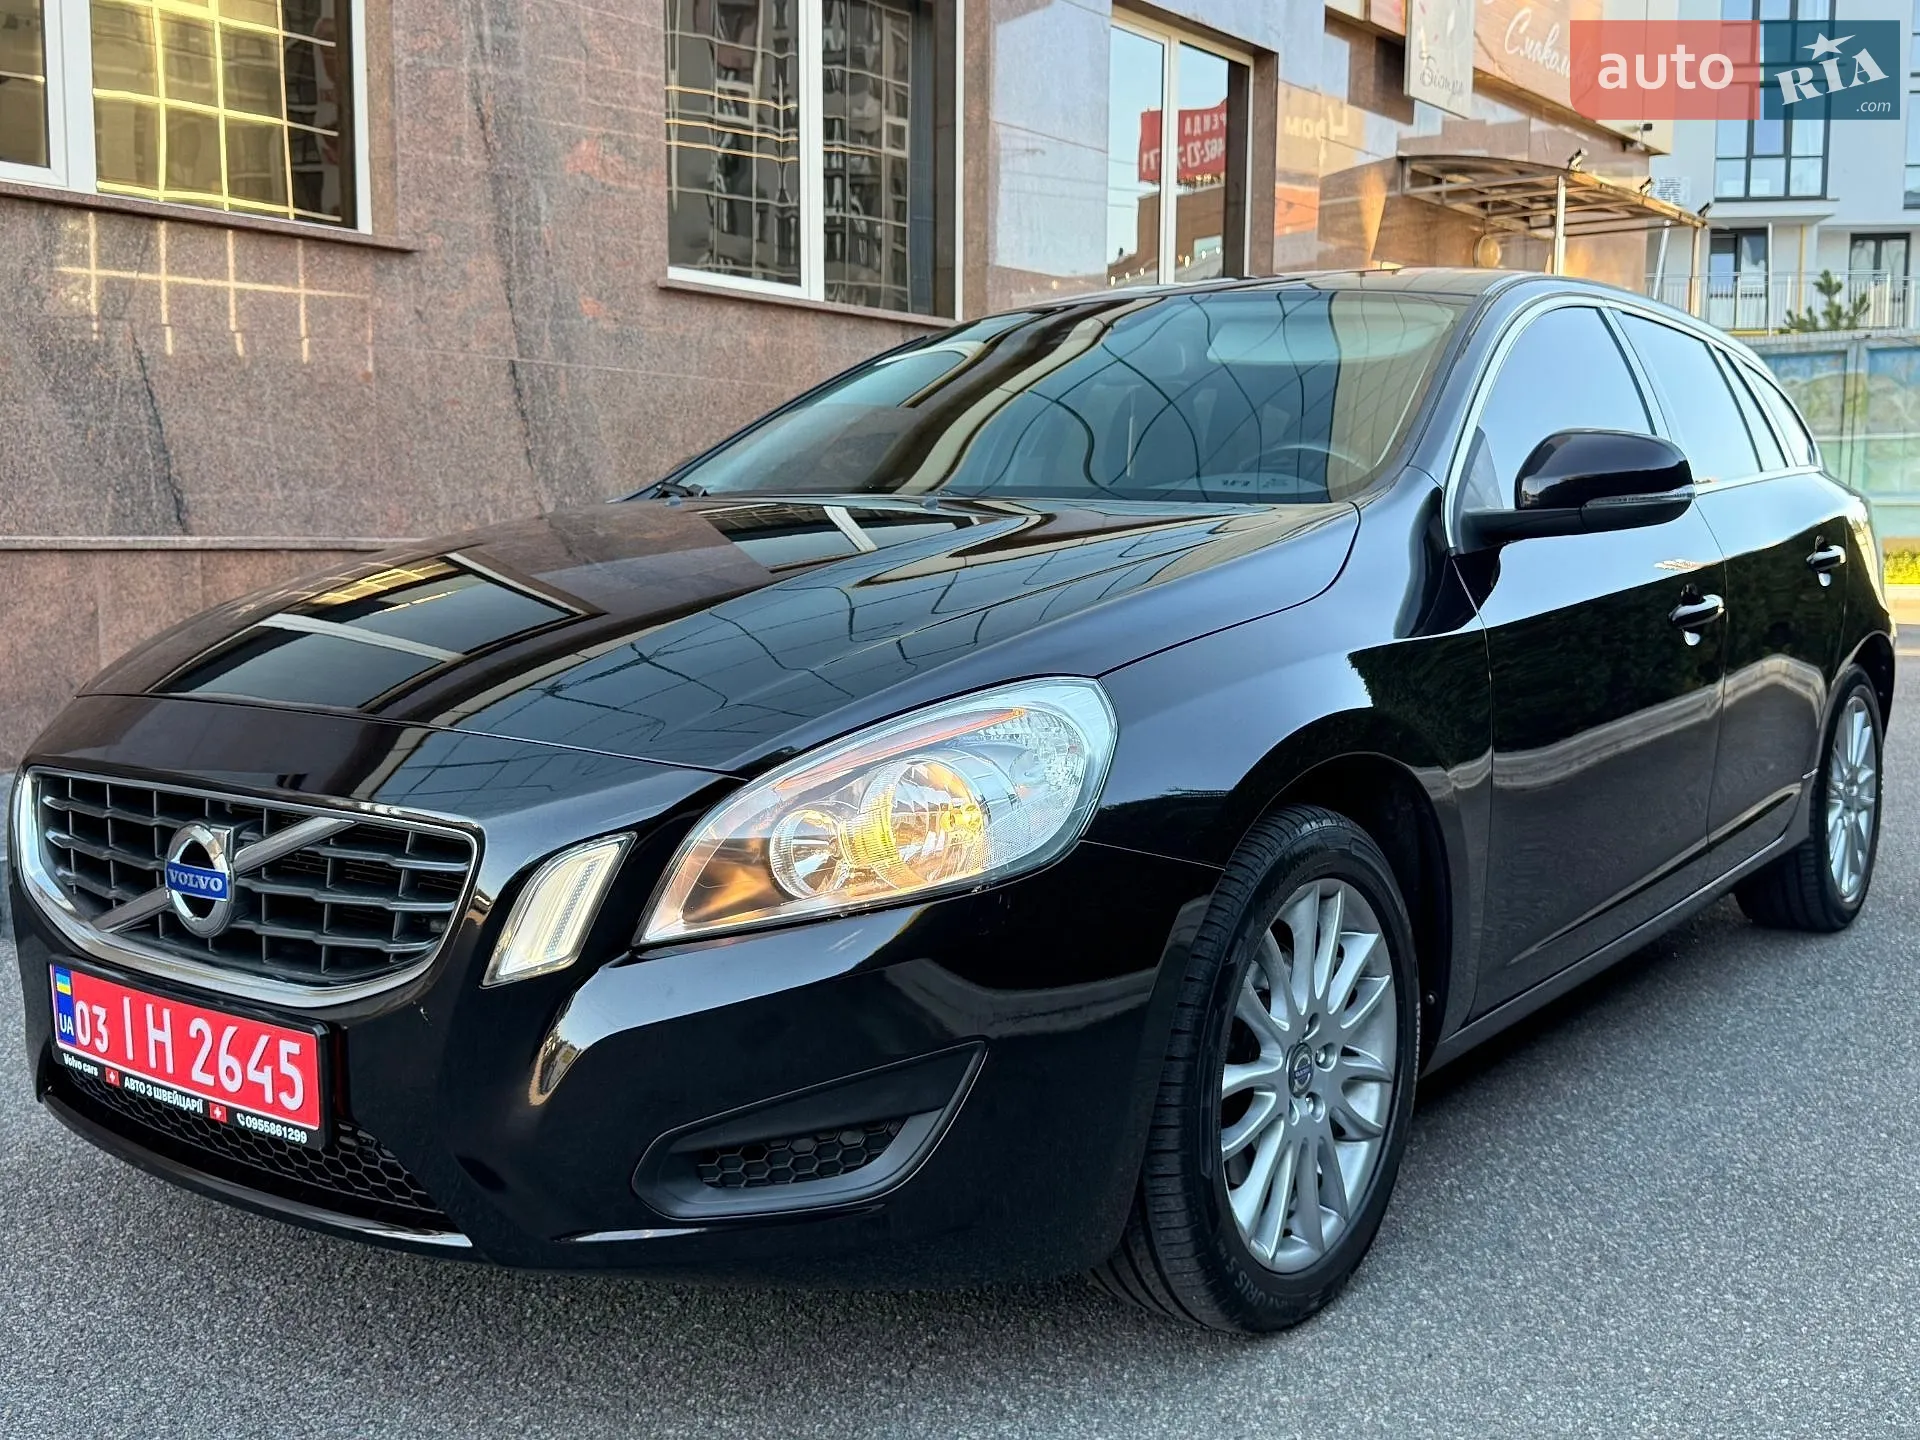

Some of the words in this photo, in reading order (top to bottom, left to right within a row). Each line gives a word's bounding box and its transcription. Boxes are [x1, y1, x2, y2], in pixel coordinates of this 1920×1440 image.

[168, 869, 222, 892] VOLVO
[59, 1014, 74, 1036] UA
[63, 1053, 82, 1071] Volvo
[83, 1062, 98, 1077] cars
[75, 1000, 109, 1053] 03
[189, 1017, 304, 1111] 2645
[124, 1077, 146, 1095] АВТО
[153, 1087, 204, 1114] ШВЕЙЦАРІЇ
[246, 1115, 307, 1144] 0955861299
